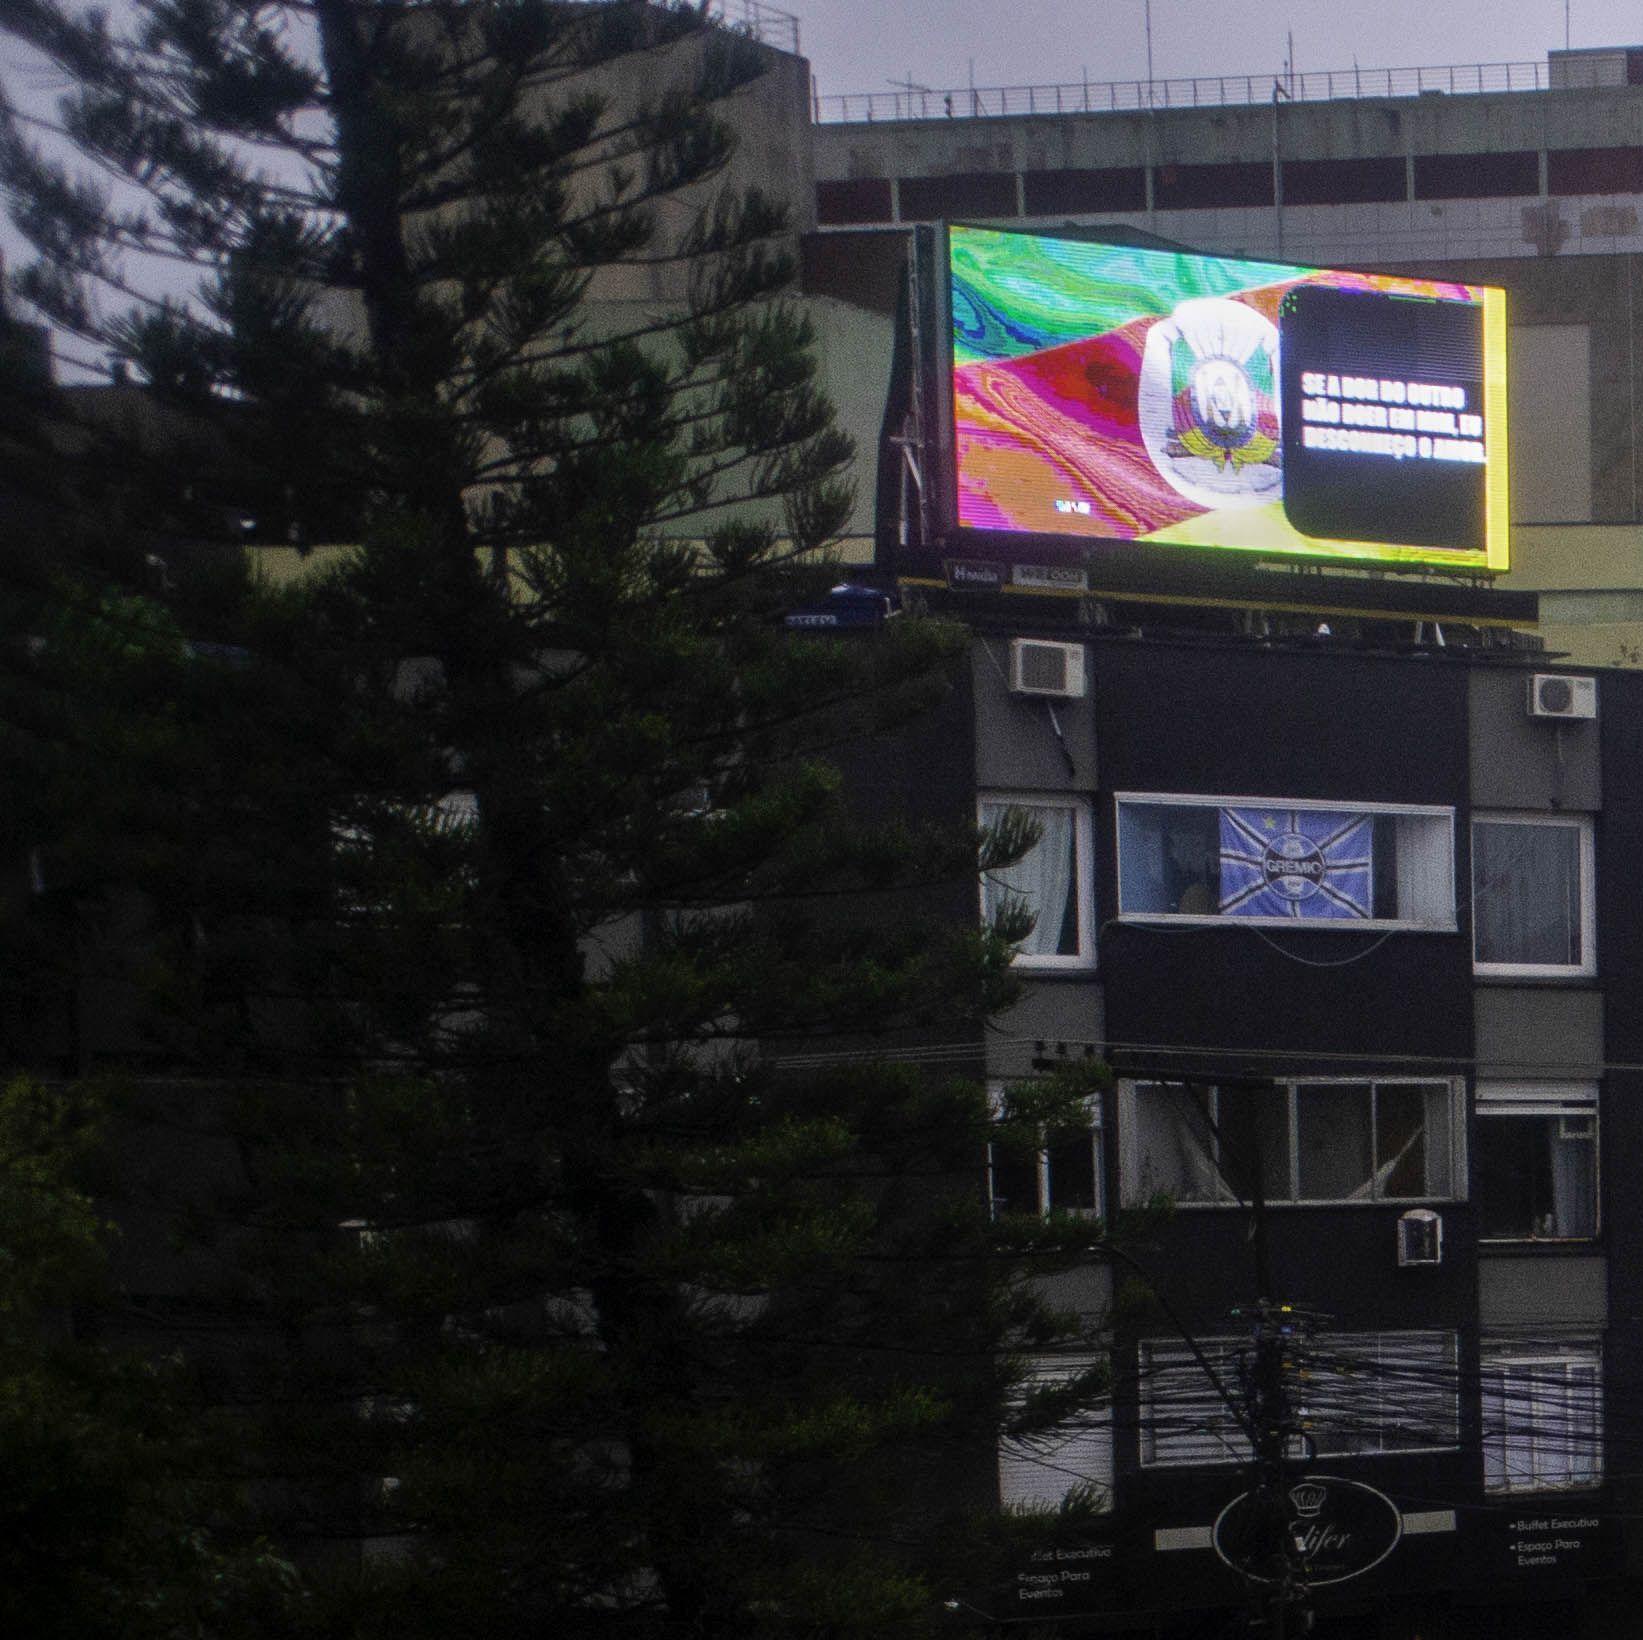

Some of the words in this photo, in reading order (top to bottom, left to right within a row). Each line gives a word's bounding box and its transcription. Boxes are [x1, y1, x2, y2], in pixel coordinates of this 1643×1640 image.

[1517, 1519, 1549, 1532] Buffet
[1551, 1517, 1600, 1530] Executivo
[1517, 1540, 1553, 1553] Espaço
[1554, 1538, 1581, 1550] Para
[1055, 1547, 1112, 1560] Executivo
[1517, 1554, 1558, 1567] Eventos
[1060, 1570, 1091, 1582] Para
[1018, 1587, 1064, 1601] Eventos
